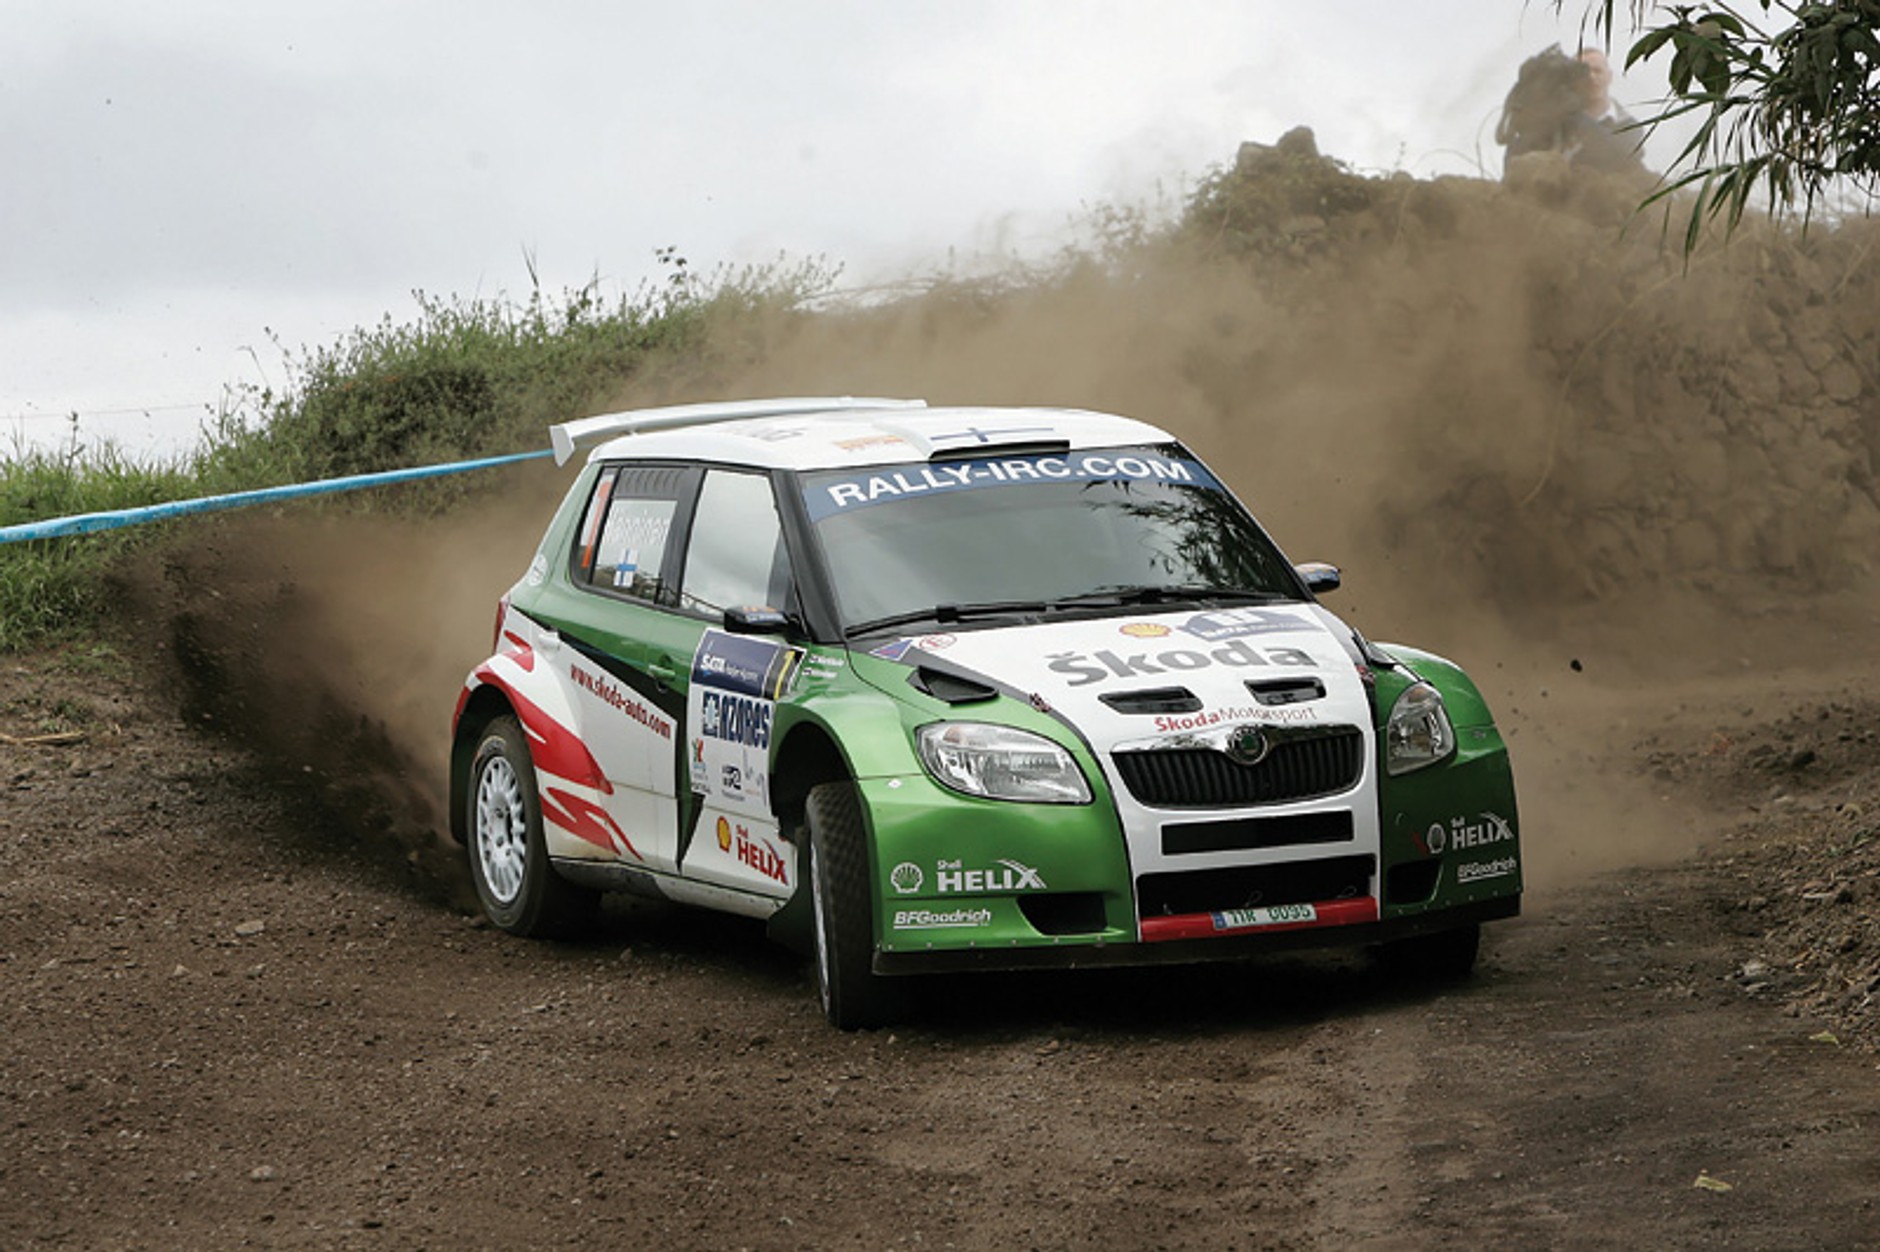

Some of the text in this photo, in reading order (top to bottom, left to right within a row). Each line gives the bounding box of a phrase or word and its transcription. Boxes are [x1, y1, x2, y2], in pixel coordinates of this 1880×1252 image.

[827, 456, 1194, 507] RALLY-IRC.COM
[1045, 640, 1318, 687] Škoda
[1451, 812, 1515, 850] HELIX
[736, 837, 789, 886] HELIX
[936, 860, 1048, 893] HELIX
[893, 909, 992, 930] BFGoodrich
